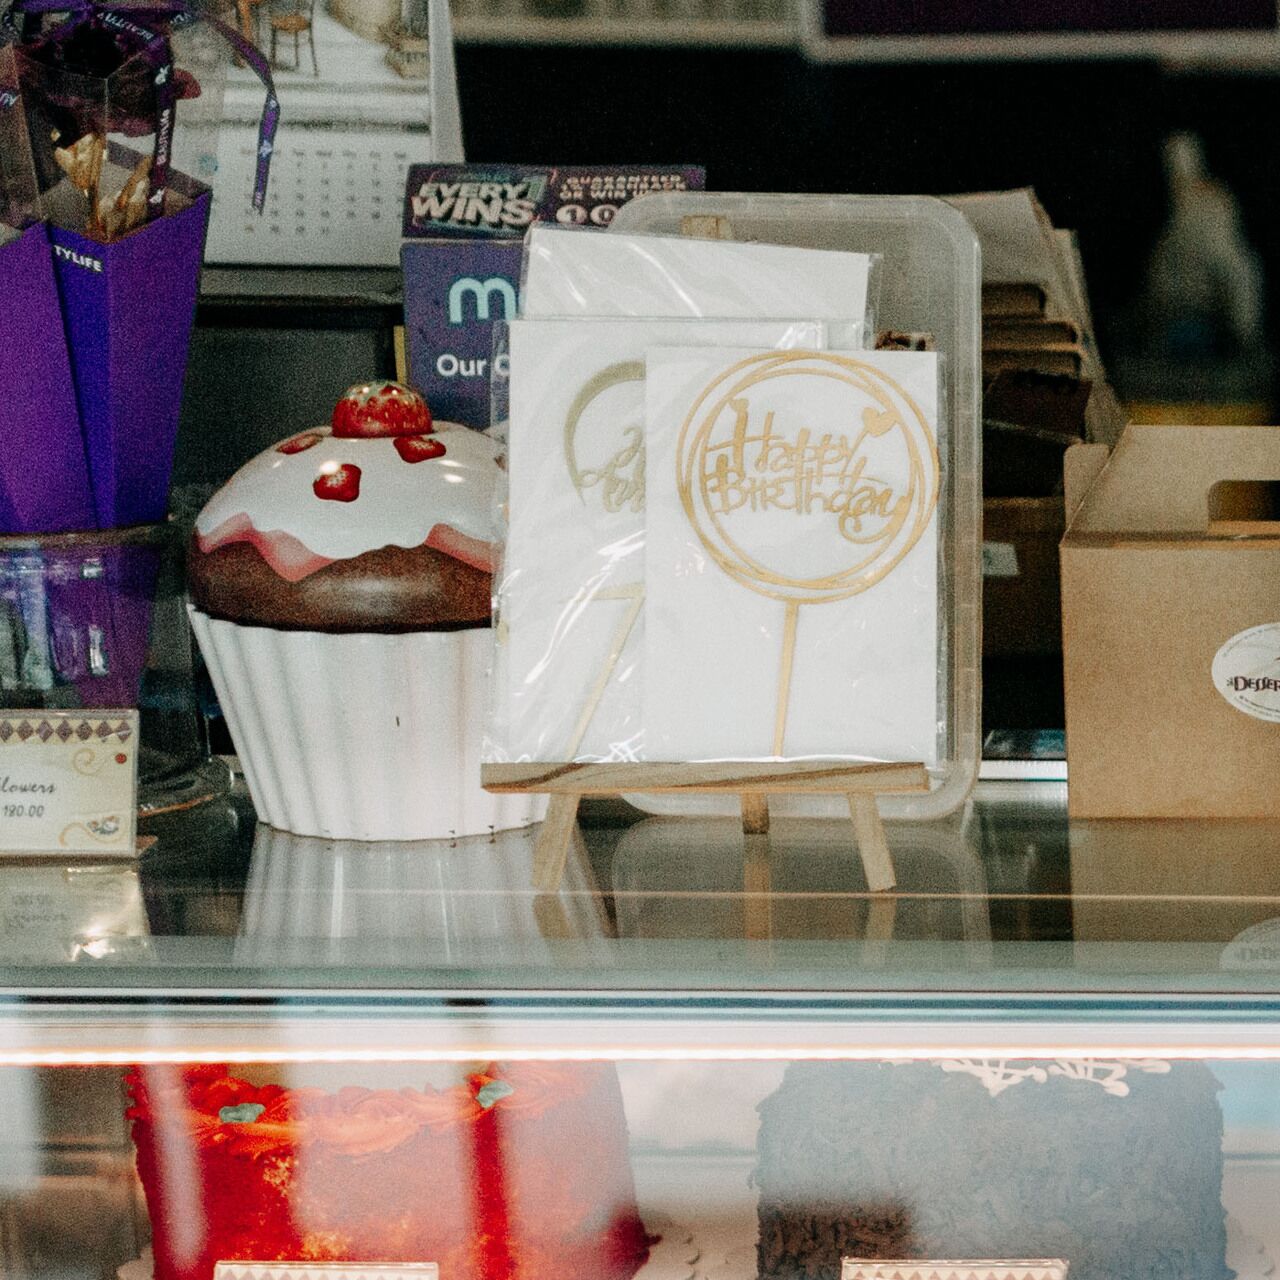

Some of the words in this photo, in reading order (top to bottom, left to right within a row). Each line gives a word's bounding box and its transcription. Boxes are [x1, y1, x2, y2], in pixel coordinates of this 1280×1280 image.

[411, 196, 537, 227] WINS
[436, 353, 487, 377] Our
[705, 398, 866, 481] Happy
[0, 776, 57, 794] lowers
